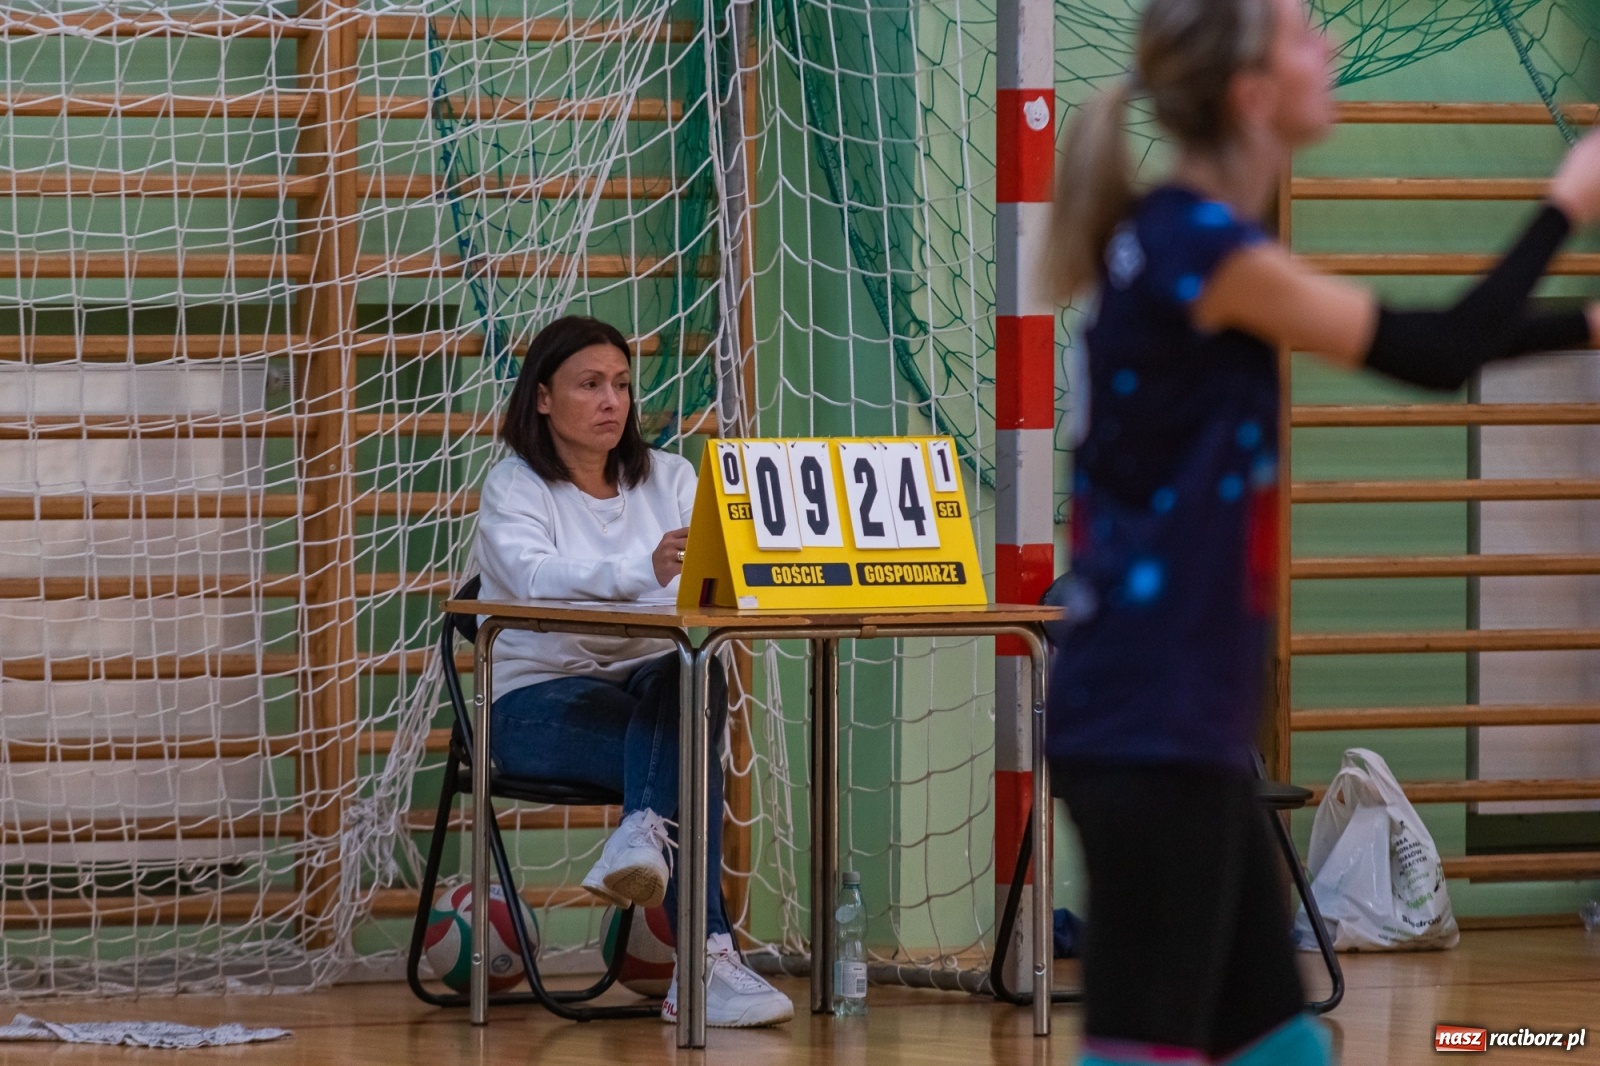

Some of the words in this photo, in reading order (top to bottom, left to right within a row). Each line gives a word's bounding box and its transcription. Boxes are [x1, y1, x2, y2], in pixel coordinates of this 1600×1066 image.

[723, 452, 739, 485] 0
[937, 449, 950, 482] 1
[730, 504, 750, 519] SET
[938, 503, 958, 517] SET
[771, 564, 825, 584] GOŚCIE
[864, 565, 958, 583] GOSPODARZE
[663, 1001, 677, 1016] FIL
